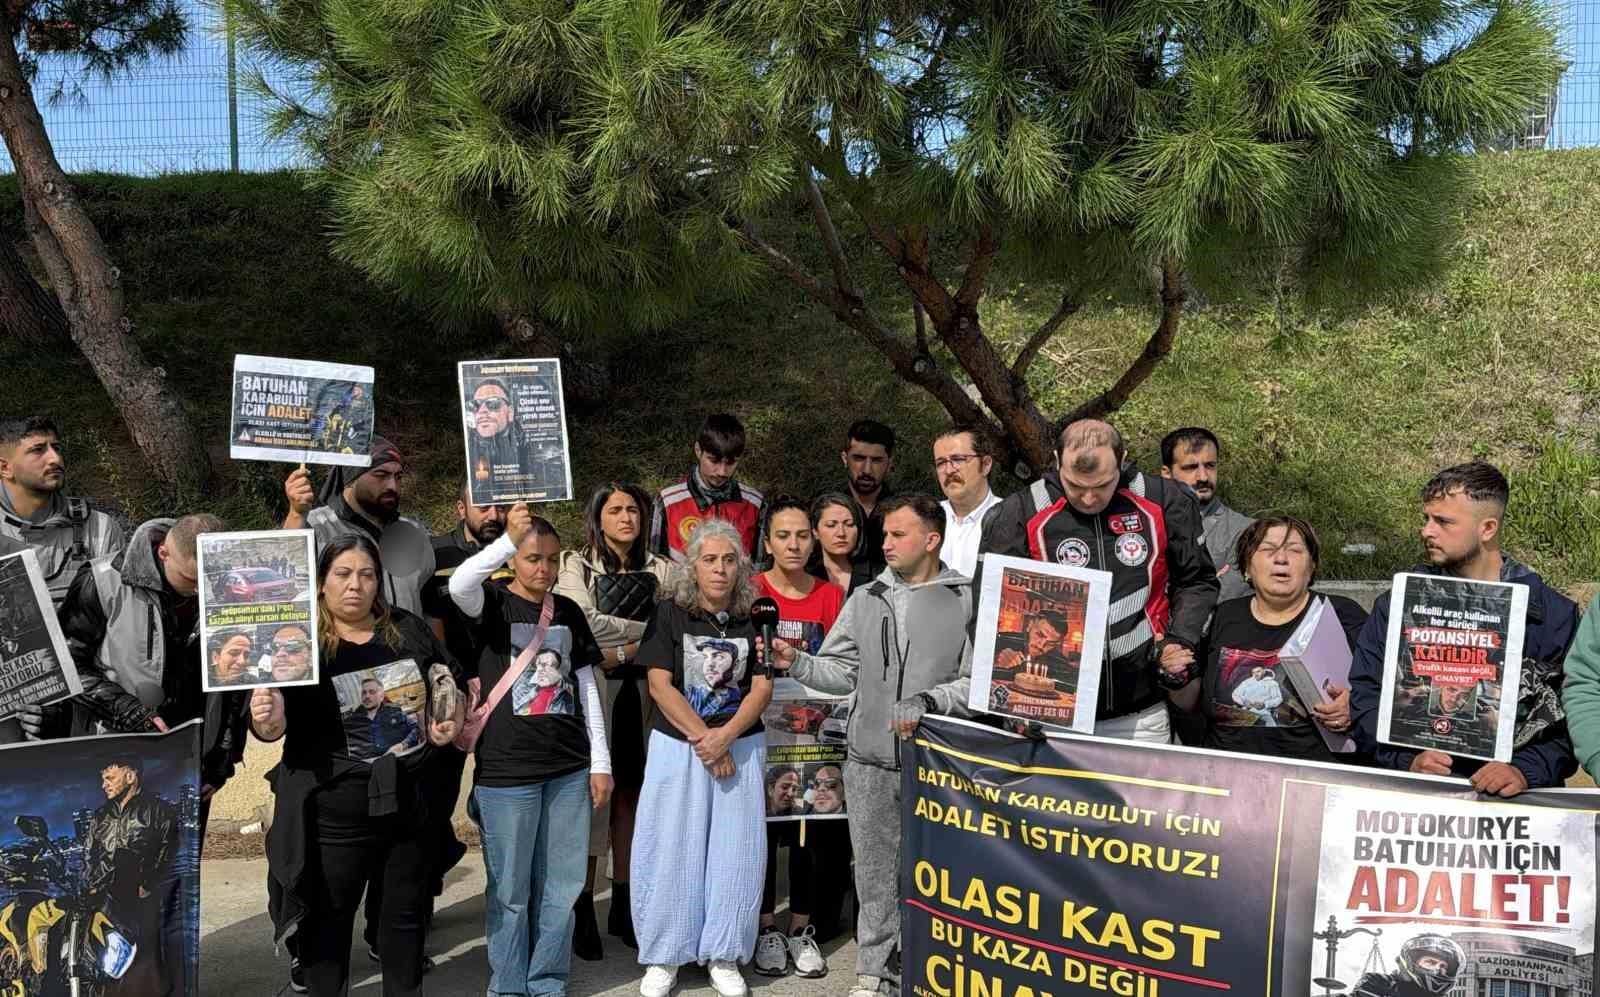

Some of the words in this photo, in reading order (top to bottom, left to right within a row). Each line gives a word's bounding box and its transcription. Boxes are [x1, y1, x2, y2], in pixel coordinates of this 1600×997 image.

[242, 376, 308, 396] BATUHAN
[242, 391, 309, 407] KARABULUT
[267, 405, 312, 420] ADALET
[1008, 575, 1085, 597] BATUHAN
[1412, 604, 1443, 616] Alkollü
[1444, 609, 1463, 619] araç
[1464, 610, 1501, 624] kullanan
[1430, 616, 1446, 626] her
[1447, 619, 1478, 630] sürücü
[1411, 629, 1495, 647] POTANSİYEL
[14, 652, 39, 670] KAST
[1414, 644, 1488, 664] KATİLDİR
[917, 766, 1001, 804] BATUHAN
[1007, 791, 1159, 827] KARABULUT
[1165, 809, 1222, 837] İÇİN
[1355, 809, 1531, 841] MOTOKURYE
[914, 797, 1012, 840] ADALET
[1019, 819, 1221, 880] İSTİYORUZ!
[1353, 836, 1499, 870] BATUHAN
[1504, 841, 1562, 875] İÇİN
[1345, 866, 1572, 924] ADALET!
[913, 860, 1041, 931] OLASI
[1061, 900, 1221, 969] KAST
[931, 918, 963, 948] BU
[972, 932, 1052, 977] KAZA
[1063, 957, 1159, 997] DEĞİL
[925, 954, 1054, 997] CİN
[913, 984, 938, 997] ALKO
